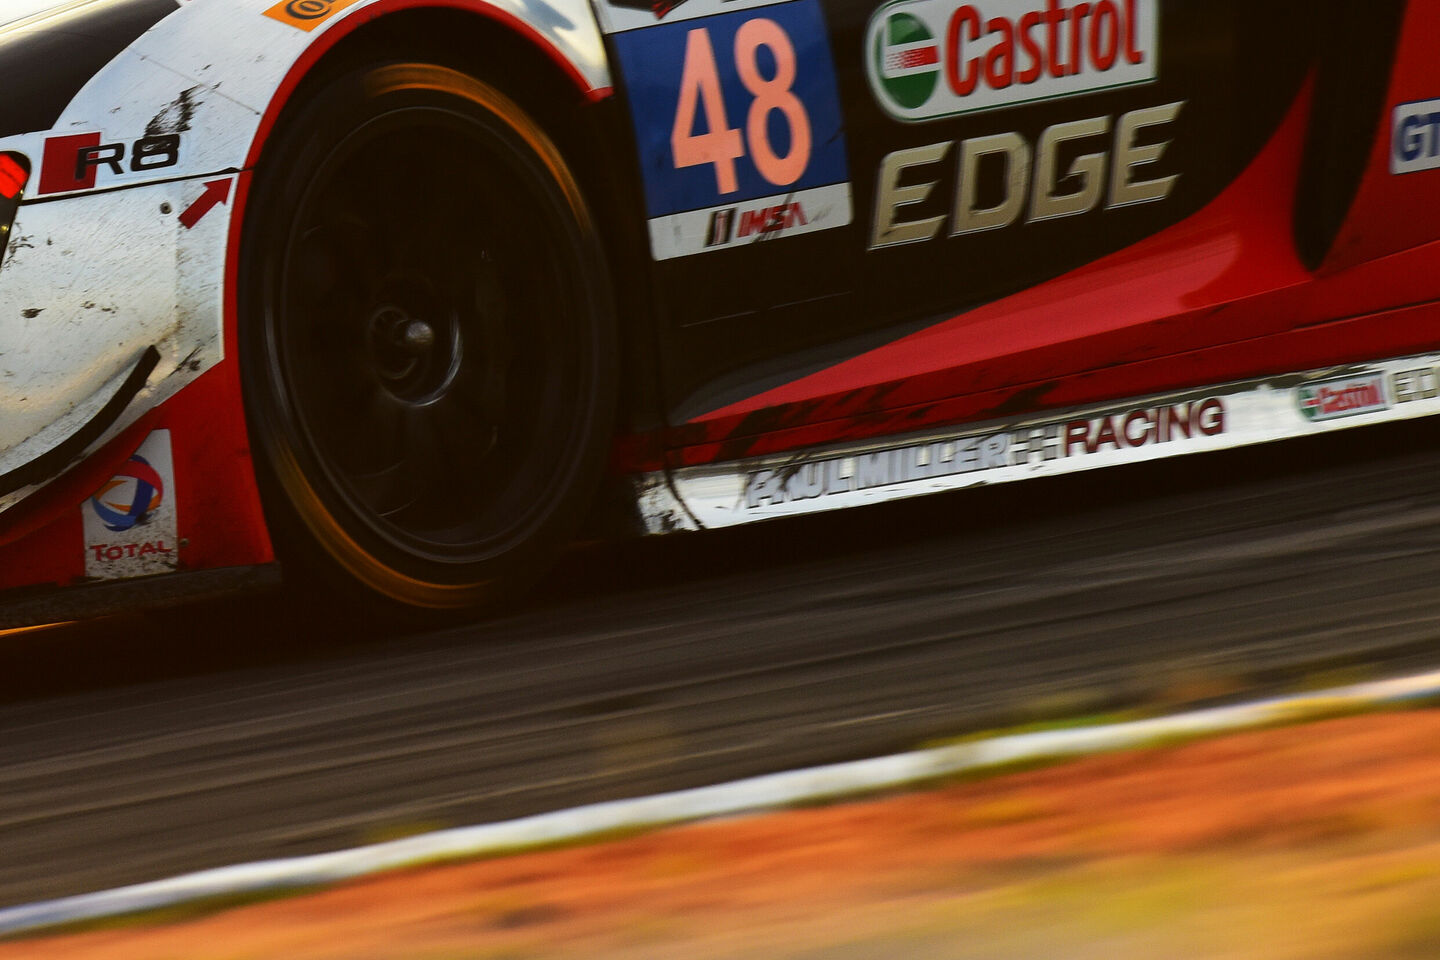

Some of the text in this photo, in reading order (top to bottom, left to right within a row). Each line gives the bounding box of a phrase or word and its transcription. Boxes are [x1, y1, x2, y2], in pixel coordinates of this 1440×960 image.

[671, 18, 812, 195] 48
[75, 133, 181, 181] R8
[867, 100, 1189, 252] EDGE
[856, 432, 1011, 488] MILLER
[1063, 397, 1228, 458] RACING
[89, 540, 172, 562] TOTAL
